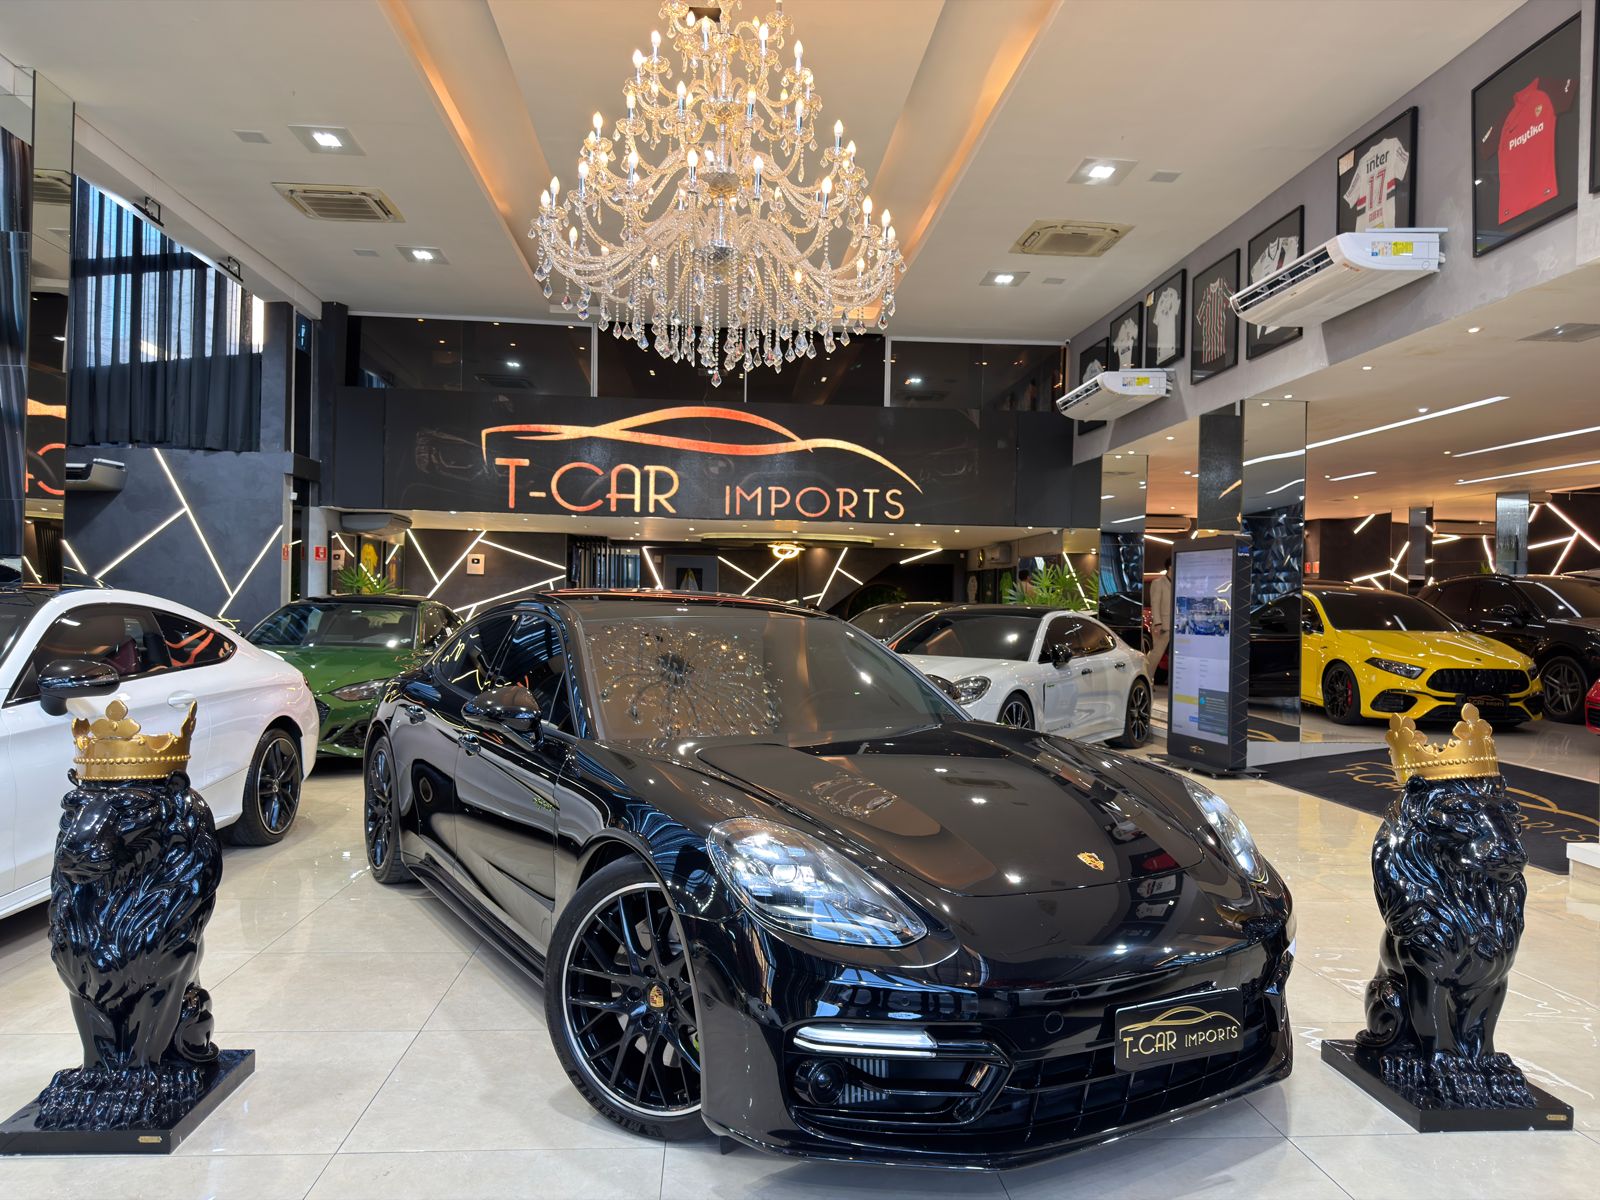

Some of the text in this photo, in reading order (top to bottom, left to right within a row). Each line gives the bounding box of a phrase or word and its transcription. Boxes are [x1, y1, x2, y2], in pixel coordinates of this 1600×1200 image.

[1509, 122, 1544, 151] Playtika
[1366, 150, 1390, 174] inter
[1368, 168, 1387, 209] 17
[494, 457, 906, 520] T-CAR IMPORTS
[1122, 1025, 1238, 1059] T-CAR IMPORTS
